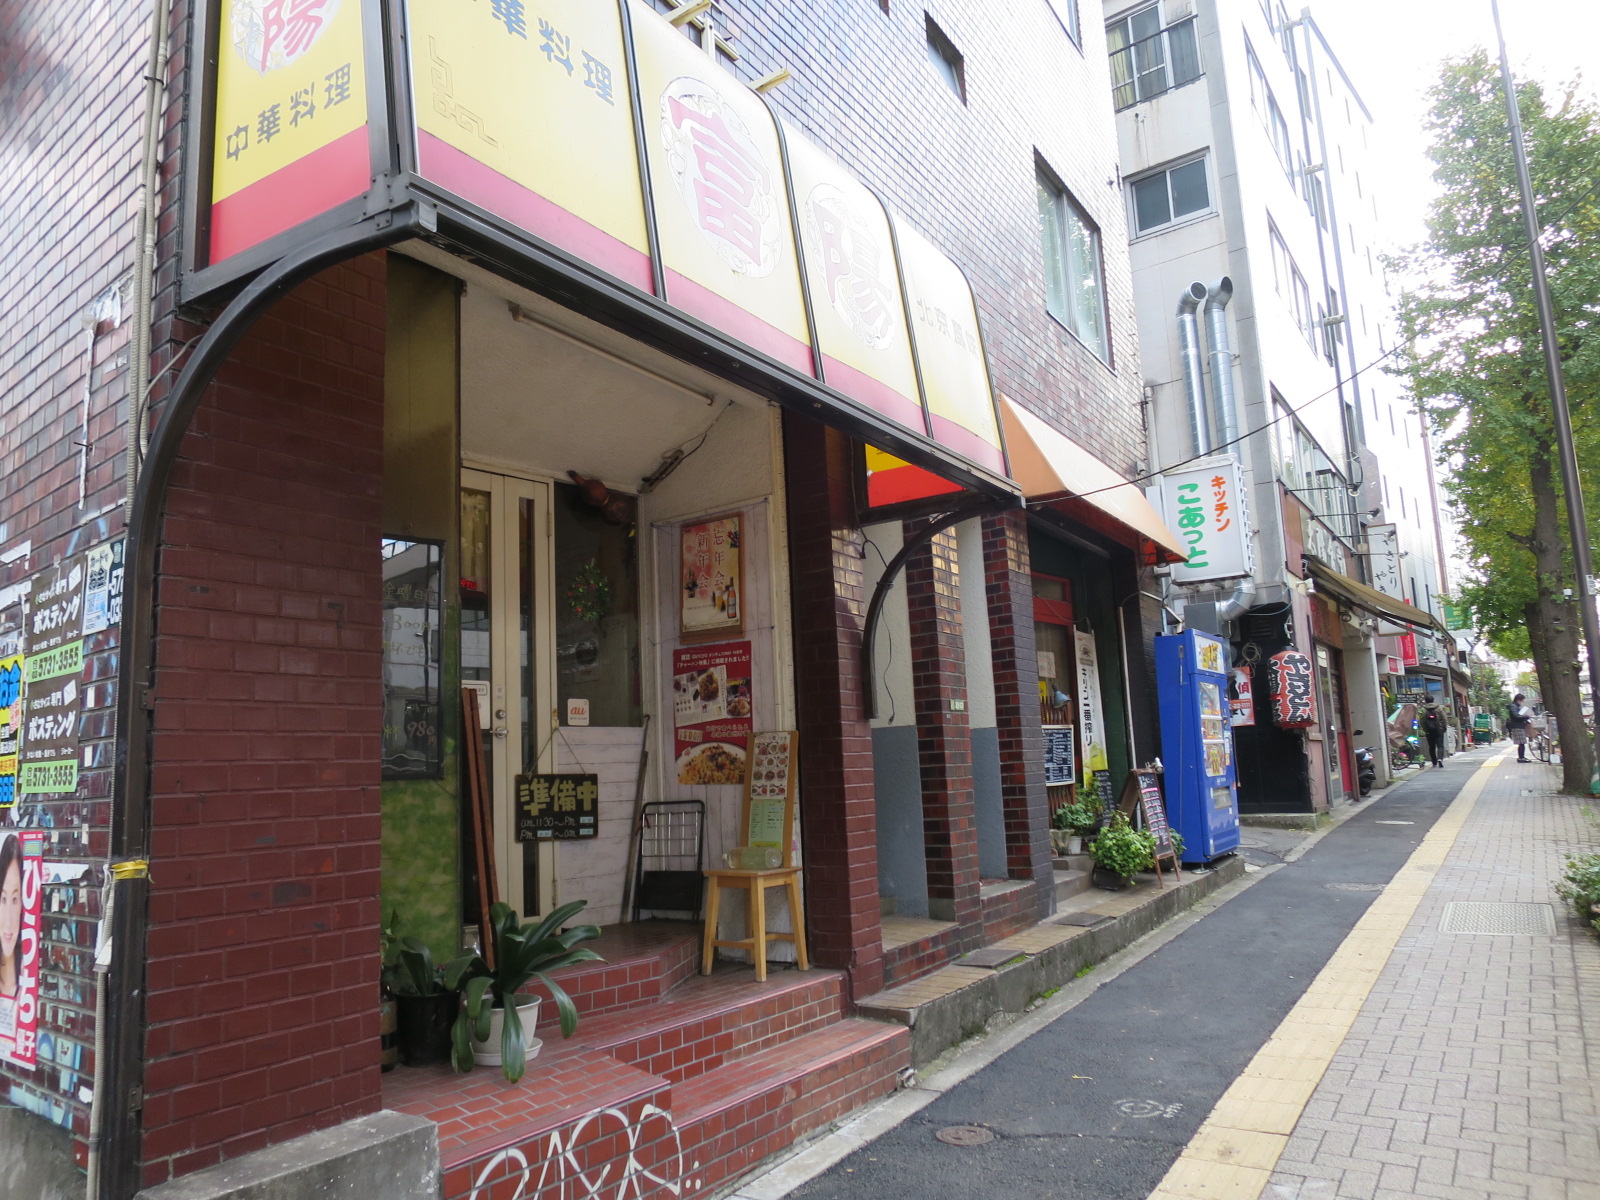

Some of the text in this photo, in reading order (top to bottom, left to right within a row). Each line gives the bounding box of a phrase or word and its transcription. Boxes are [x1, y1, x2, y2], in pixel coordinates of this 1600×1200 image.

[473, 0, 615, 106] 華料理
[226, 62, 351, 161] 中華料理
[1177, 483, 1209, 568] こあっと
[1211, 475, 1231, 532] キッチン
[697, 532, 709, 590] 新年会
[713, 523, 725, 586] 忘年会
[1382, 537, 1398, 589] やきとり
[33, 593, 81, 634] ポスティング
[384, 582, 423, 601] 金曜日
[39, 646, 79, 678] 5731-3555
[28, 710, 76, 741] ポスティング
[407, 720, 435, 738] 980
[571, 706, 587, 716] au
[33, 764, 74, 787] 5731-3555
[520, 778, 597, 816] 準備中
[19, 859, 41, 1024] ひうち
